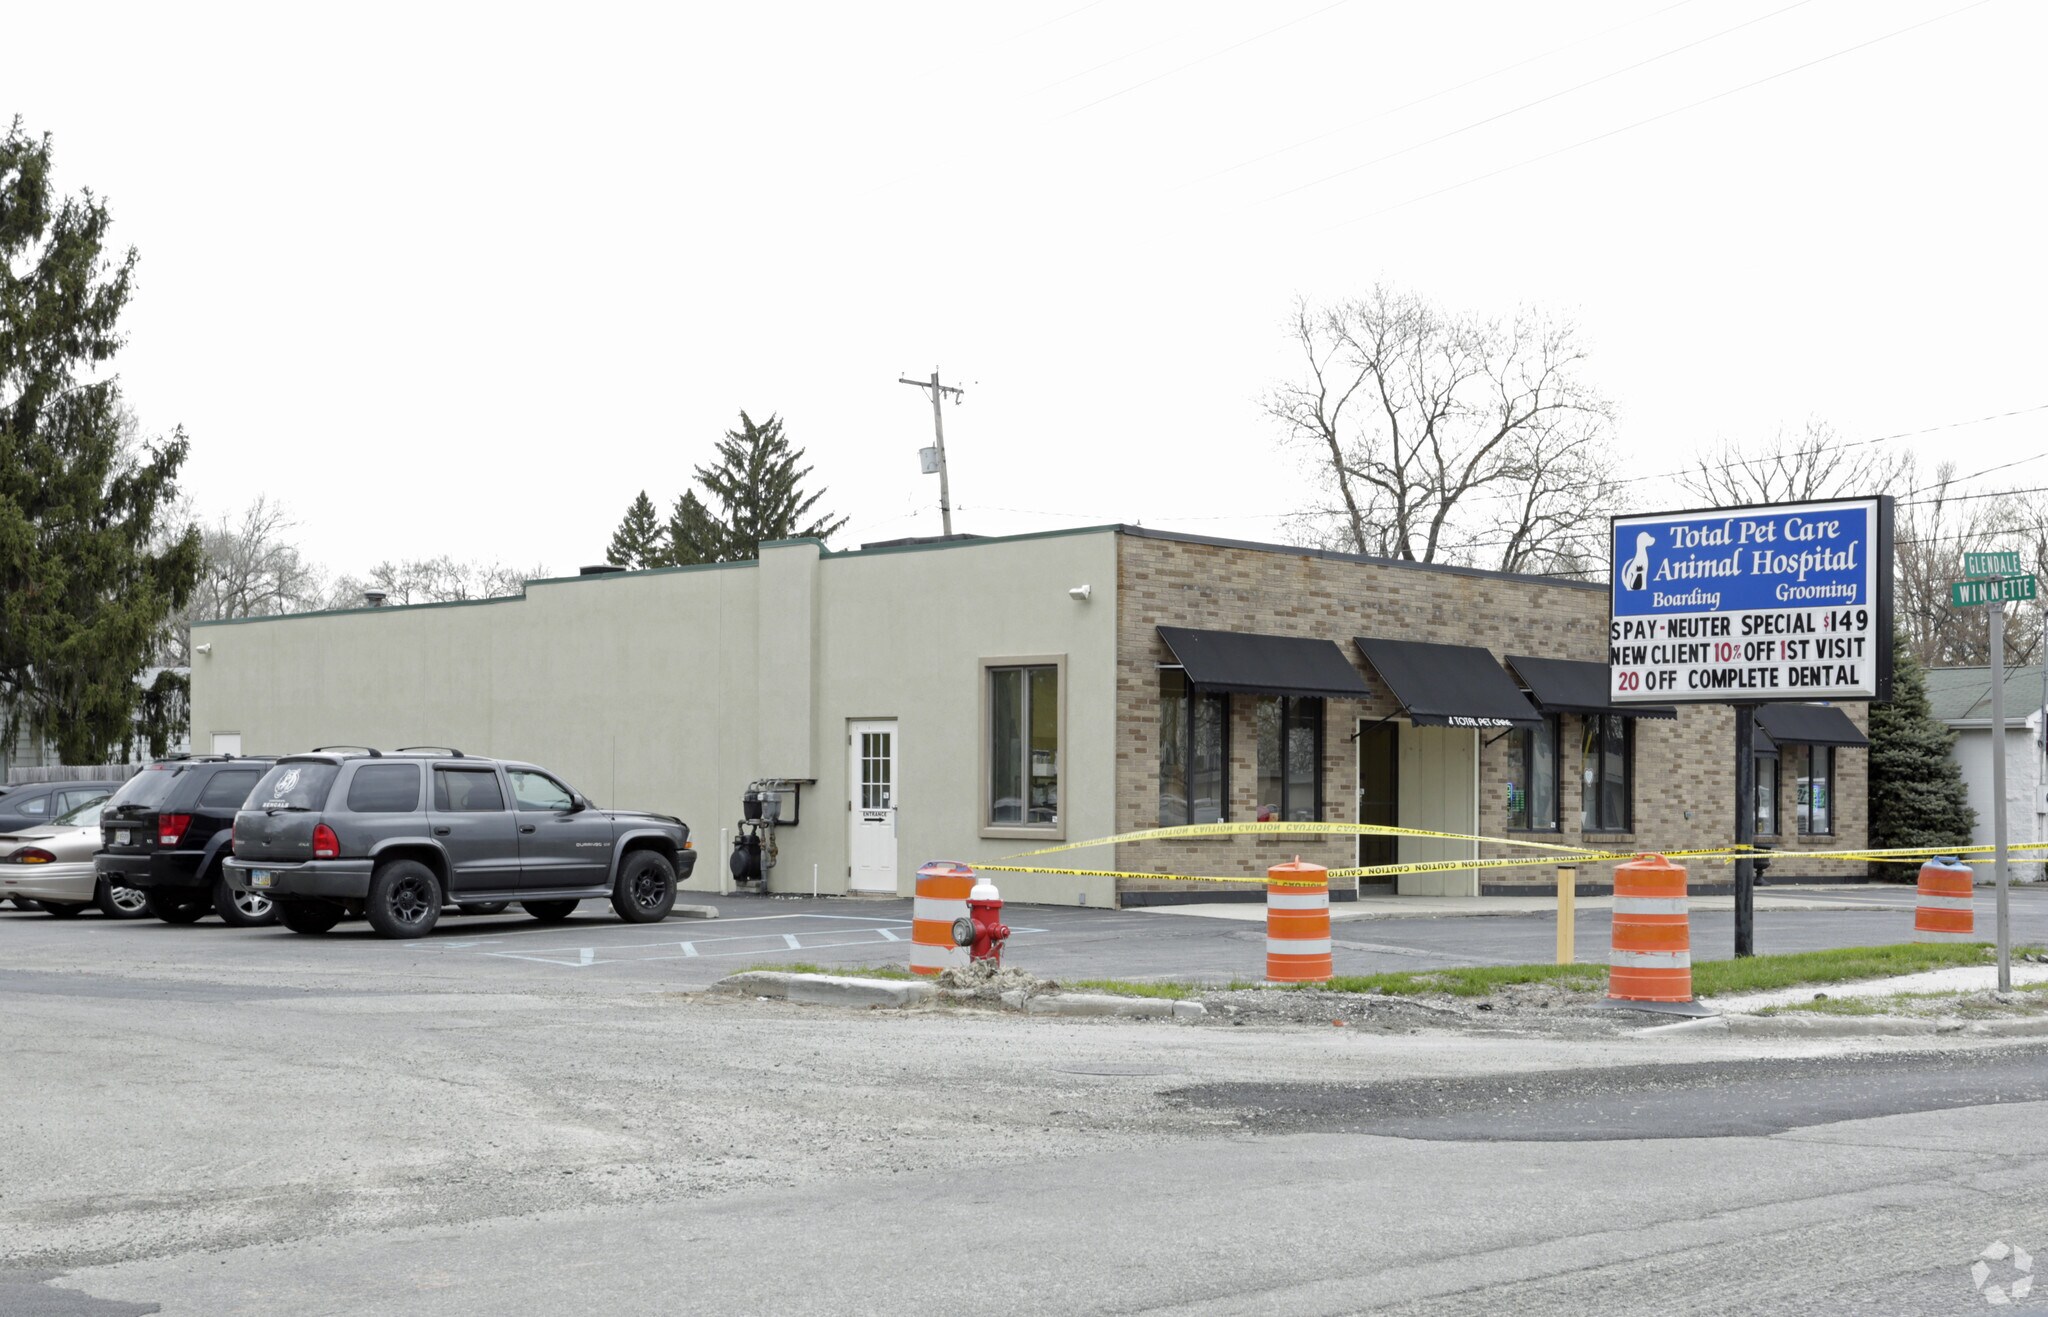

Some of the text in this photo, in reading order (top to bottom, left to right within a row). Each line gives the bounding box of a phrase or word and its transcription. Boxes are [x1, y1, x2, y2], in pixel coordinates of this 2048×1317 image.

[1670, 517, 1841, 549] Total Pet Care
[1653, 540, 1859, 582] Animal Hospital
[1968, 554, 2019, 574] GLENDALE
[1652, 587, 1721, 611] Boarding
[1775, 580, 1858, 605] Grooming
[1959, 578, 2031, 603] WINNETTE
[1741, 612, 1816, 636] SPECIAL
[1823, 609, 1869, 634] $149
[1610, 637, 1866, 666] NEW CLIENT 10% OFF 1ST VISIT
[1618, 665, 1860, 692] 20 OFF COMPLETE DENTAL
[1454, 716, 1478, 726] TOTAL
[1478, 718, 1492, 726] PET
[1368, 865, 1410, 874] CAUTION
[1415, 862, 1456, 871] CAUTION
